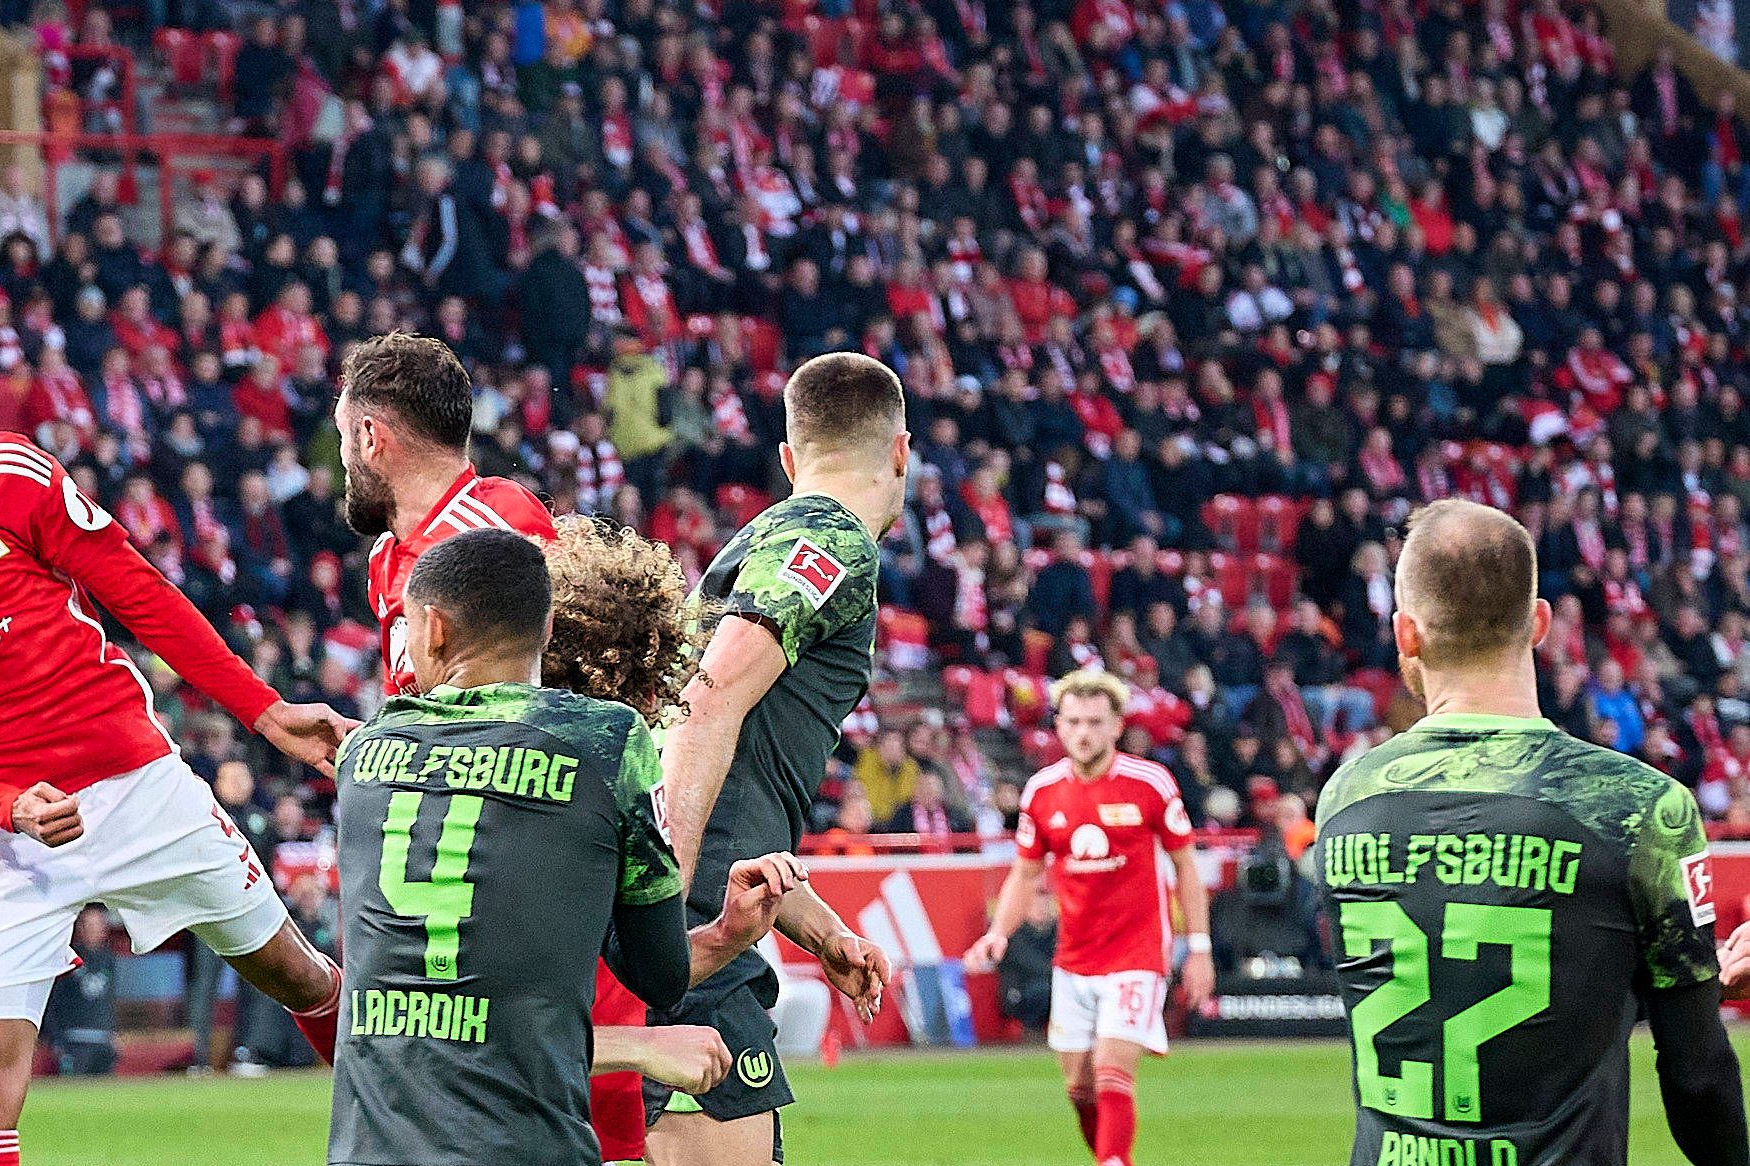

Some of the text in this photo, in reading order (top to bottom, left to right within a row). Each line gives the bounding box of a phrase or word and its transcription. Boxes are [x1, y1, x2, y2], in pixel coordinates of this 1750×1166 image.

[353, 740, 580, 802] WOLFSBURG
[379, 791, 483, 980] 4
[1324, 832, 1583, 895] WOLFSBURG
[351, 989, 490, 1044] LACROIX
[1341, 902, 1551, 1121] 27
